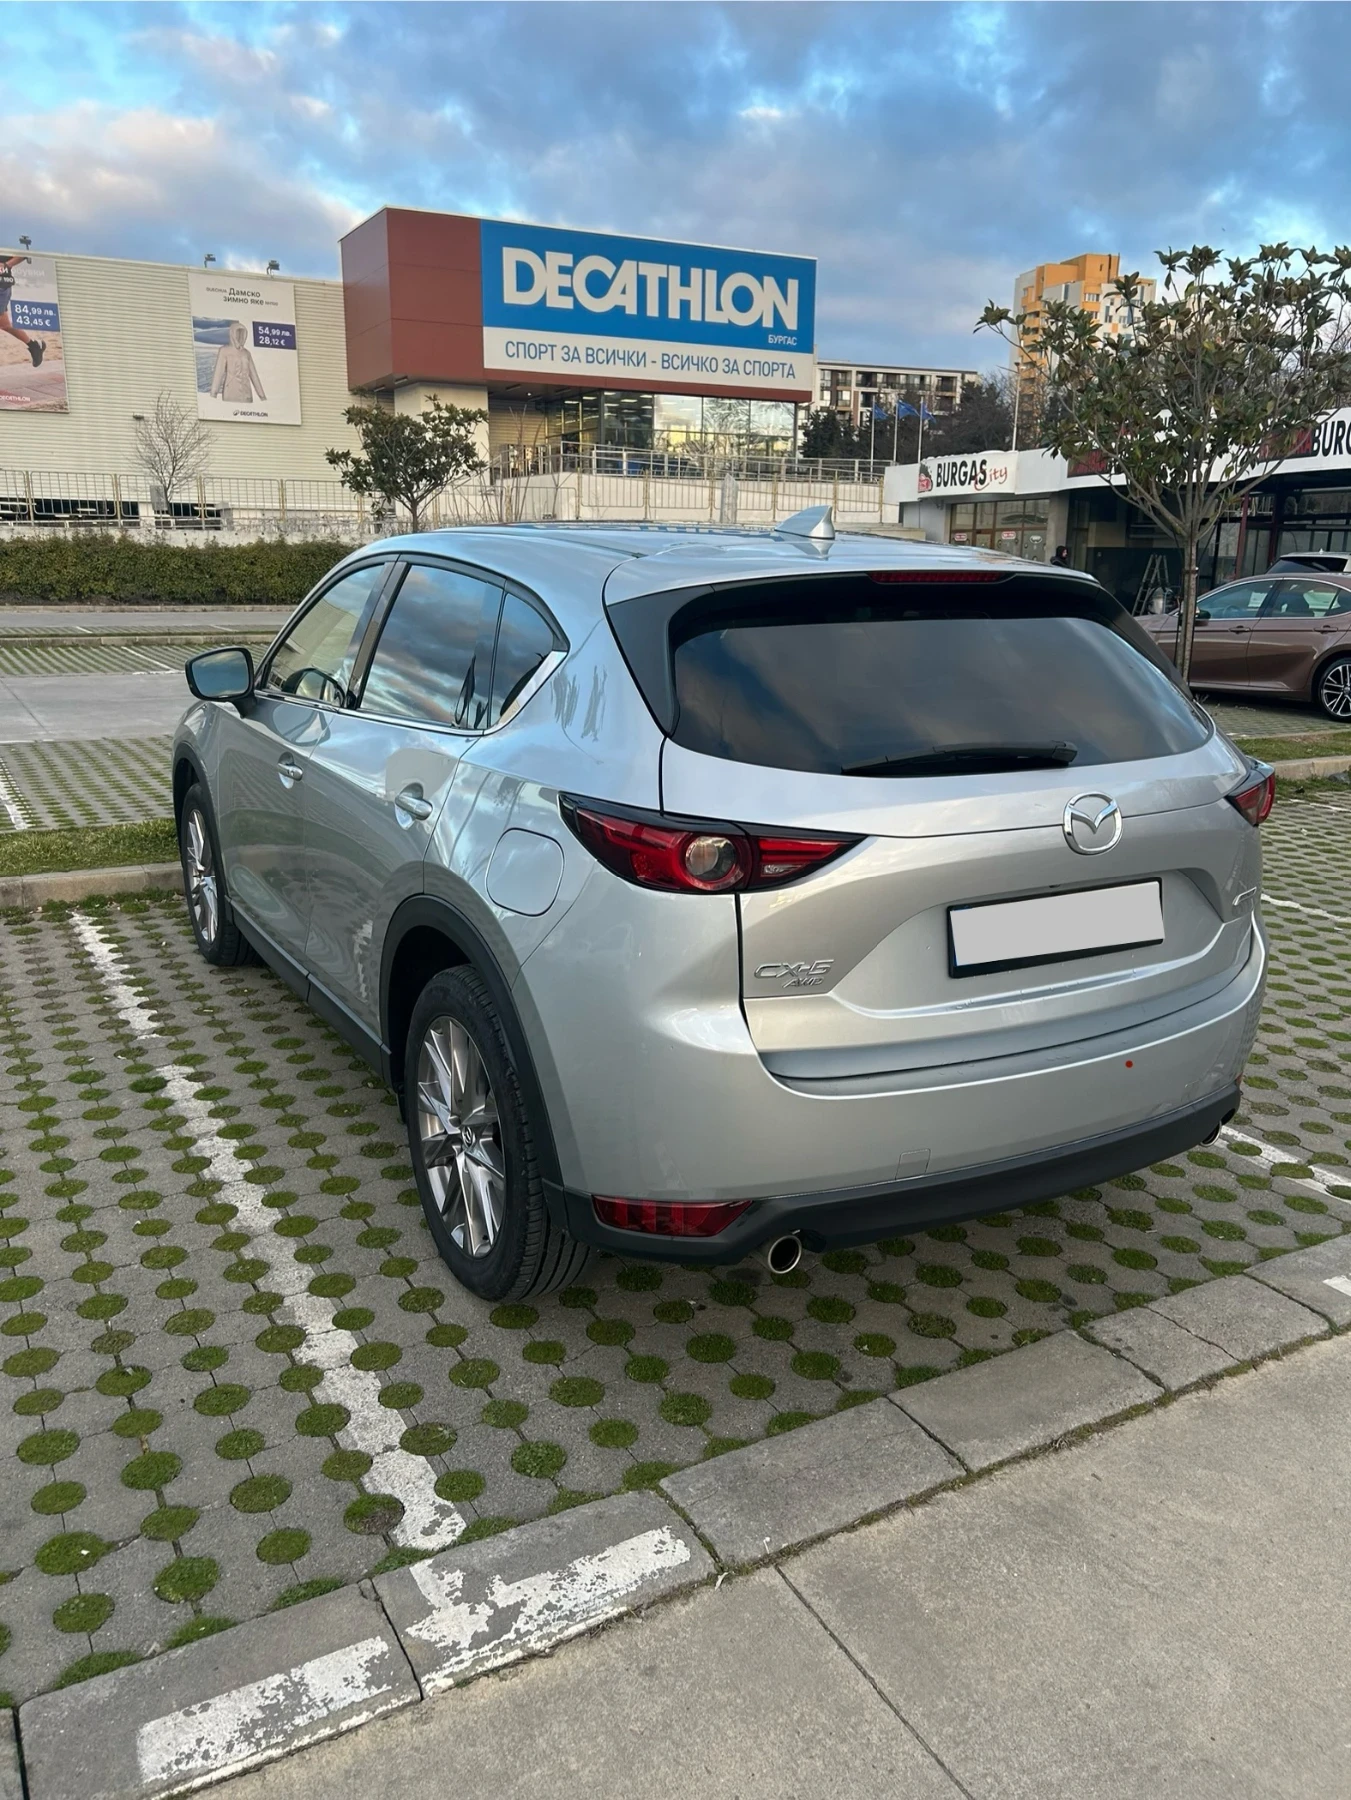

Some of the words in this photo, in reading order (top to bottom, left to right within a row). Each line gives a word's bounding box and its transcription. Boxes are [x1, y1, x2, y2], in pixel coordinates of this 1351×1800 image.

[228, 287, 261, 298] Дамско
[502, 246, 799, 331] DECATHLON
[223, 296, 249, 304] зимно
[250, 298, 264, 306] яке
[14, 304, 42, 315] 84,99
[16, 315, 43, 327] 43,45
[258, 326, 280, 336] 54,99
[259, 336, 280, 346] 28,12
[768, 334, 797, 346] БУРГАС
[505, 340, 557, 361] СПОРТ
[561, 345, 581, 364] ЗА
[585, 347, 647, 368] ВСИЧКИ
[661, 353, 719, 374] ВСИЧКО
[722, 358, 740, 376] ЗА
[743, 359, 796, 380] СПОРТА
[936, 459, 987, 488] BURGAS
[974, 466, 1008, 491] City
[754, 959, 834, 979] CX-5
[782, 976, 824, 988] AWD
